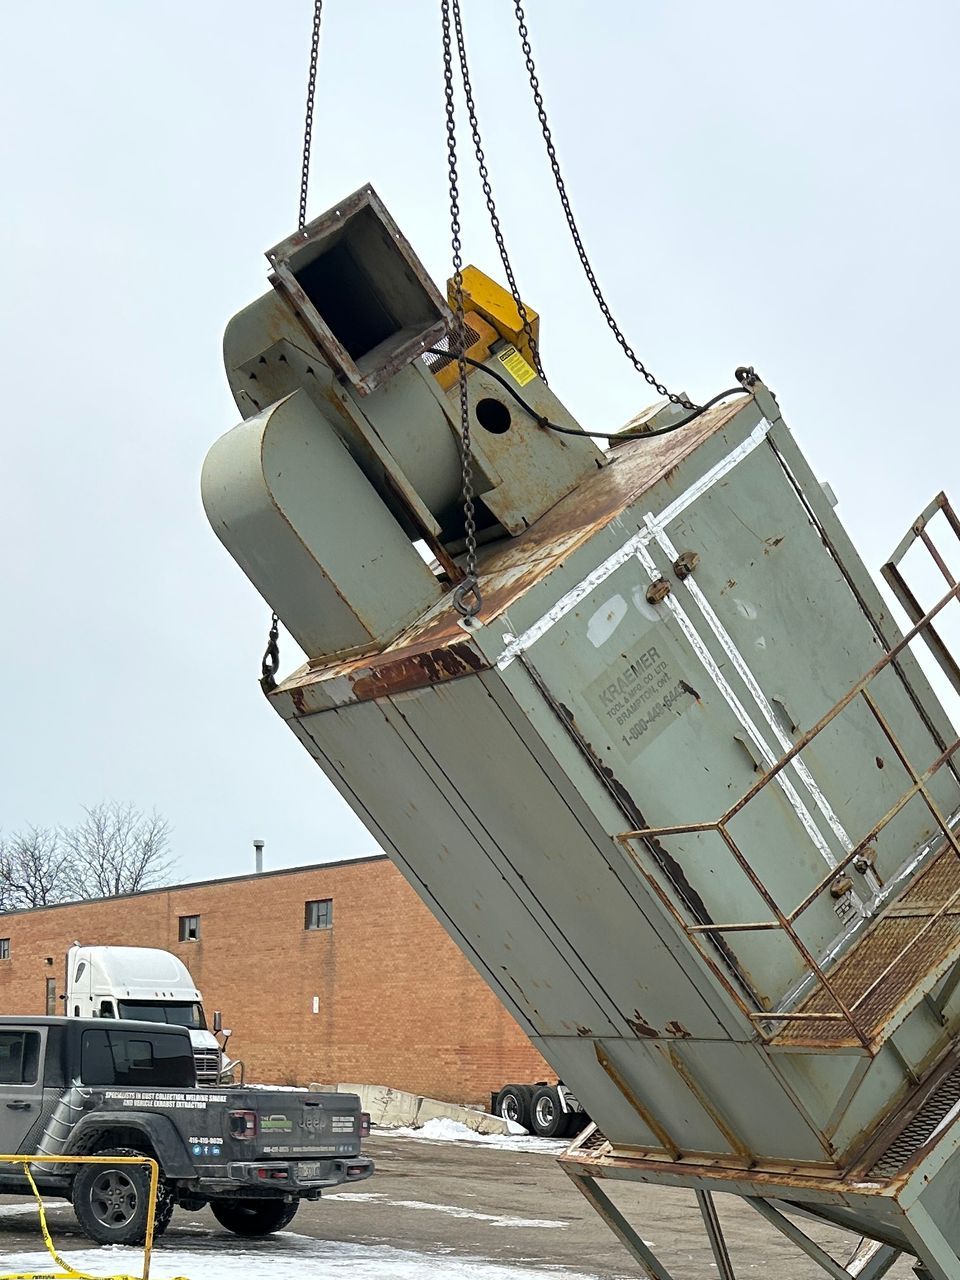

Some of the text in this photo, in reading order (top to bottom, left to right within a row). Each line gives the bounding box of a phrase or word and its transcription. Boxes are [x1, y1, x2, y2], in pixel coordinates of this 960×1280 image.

[597, 646, 661, 707] KRAEMER
[606, 700, 625, 718] TOOL
[643, 671, 655, 685] CO.
[653, 660, 669, 675] LTD.
